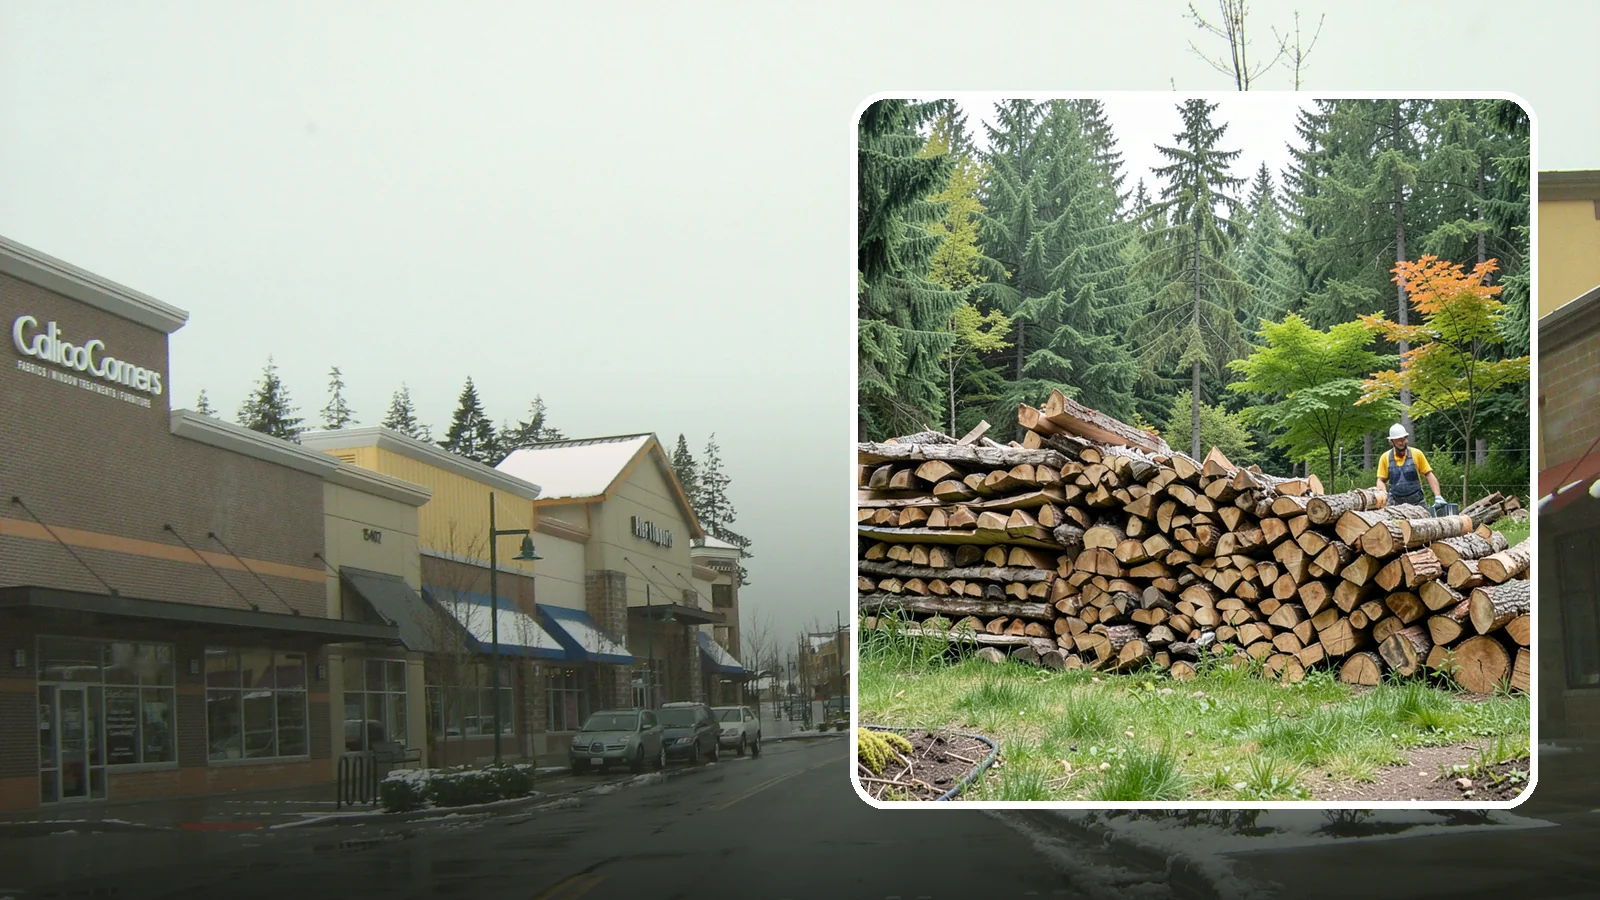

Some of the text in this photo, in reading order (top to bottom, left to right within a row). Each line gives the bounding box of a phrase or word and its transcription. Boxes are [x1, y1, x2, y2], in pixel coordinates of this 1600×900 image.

[17, 360, 46, 377] FABRICS
[51, 371, 78, 387] WINDOW
[78, 378, 116, 398] TREATMENTS
[120, 391, 151, 408] FURNITURE
